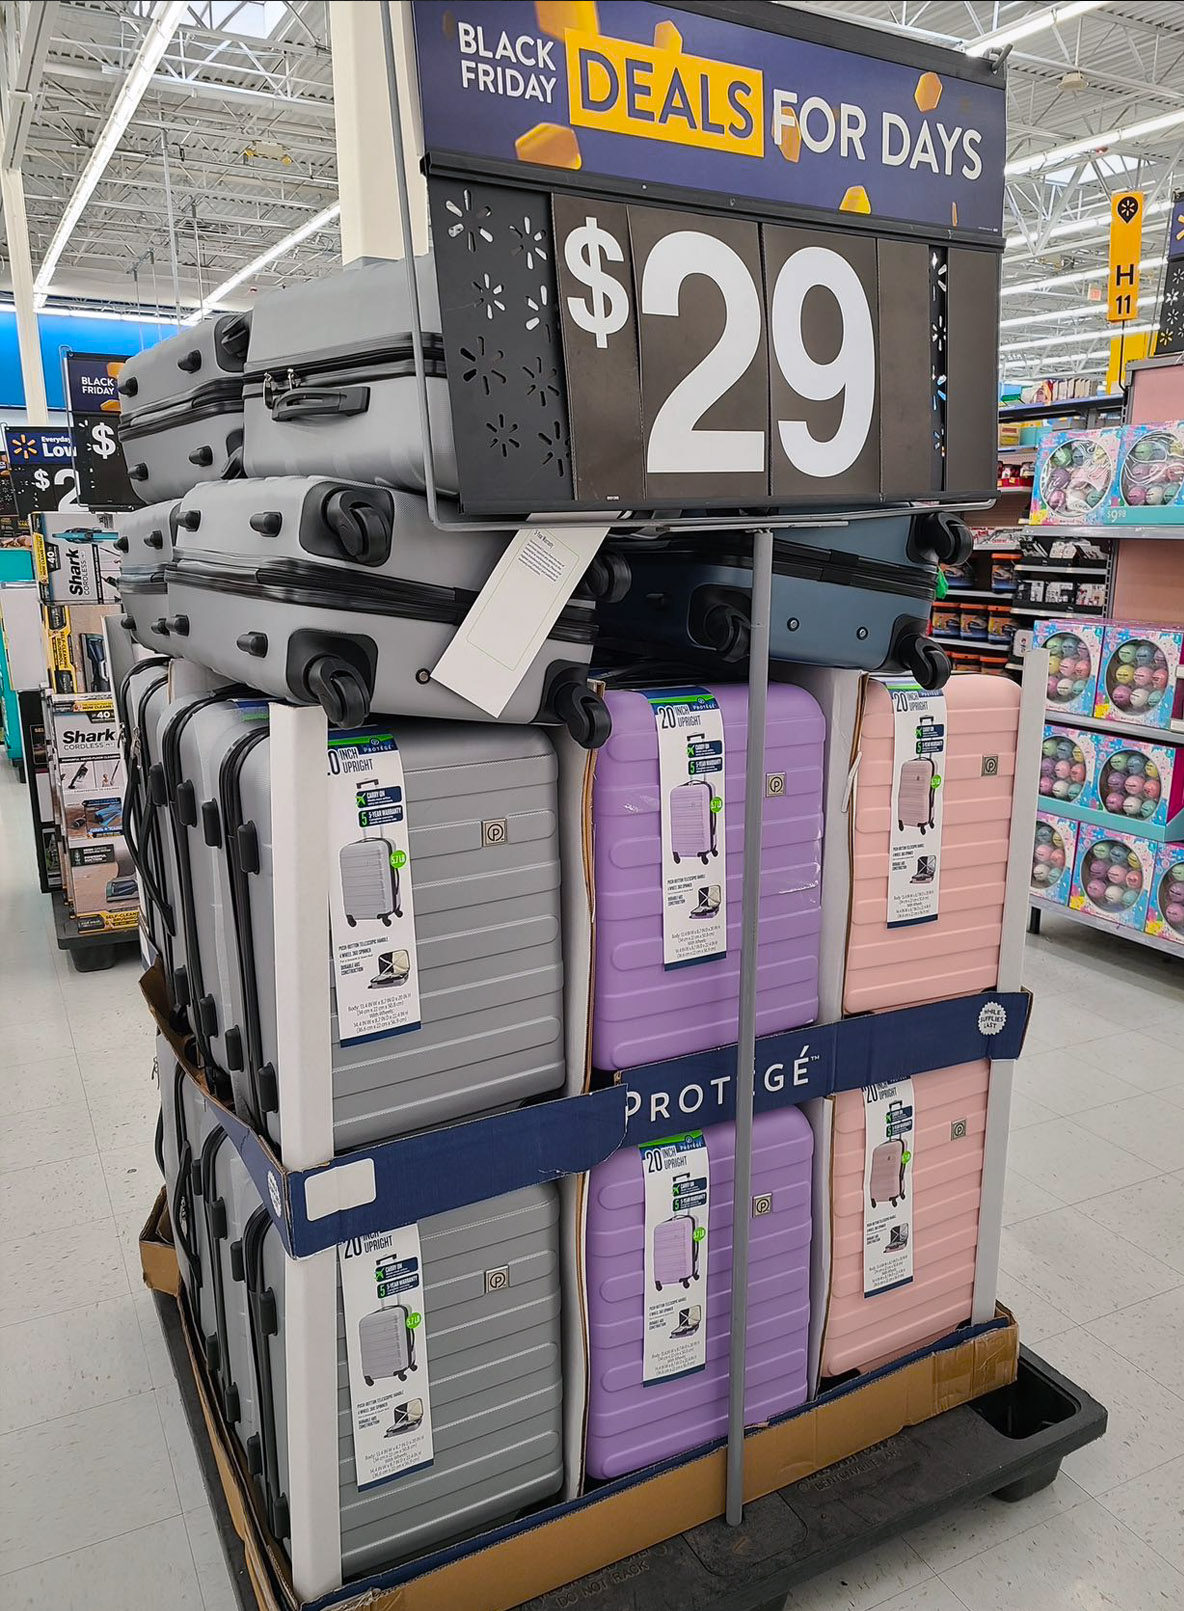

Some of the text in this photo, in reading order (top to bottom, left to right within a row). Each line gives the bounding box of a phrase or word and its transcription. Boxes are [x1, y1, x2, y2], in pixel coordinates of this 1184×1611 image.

[457, 21, 556, 71] BLACK
[461, 60, 557, 104] FRIDAY
[579, 47, 983, 181] DEALS FOR DAYS
[1115, 263, 1134, 287] H
[1115, 295, 1131, 315] 11
[563, 216, 876, 478] $29
[81, 376, 114, 387] BLACK
[82, 385, 115, 396] FRIDAY
[42, 443, 77, 458] Low
[92, 422, 116, 459] $
[66, 548, 83, 596] Shark
[80, 559, 91, 596] CORDLESS
[893, 692, 908, 713] 20
[97, 711, 111, 719] 40
[658, 705, 690, 730] 20 INCH
[677, 715, 701, 727] UPRIGHT
[63, 729, 115, 744] Shark
[63, 743, 104, 751] CORDLESS
[339, 747, 358, 760] INCH
[342, 758, 373, 774] UPRIGHT
[625, 1045, 810, 1122] PROTGÉ
[646, 1146, 676, 1173] 20 INCH
[664, 1155, 688, 1170] UPRIGHT
[364, 1235, 393, 1254] UPRIGHT
[557, 1591, 579, 1608] DO
[581, 1578, 608, 1598] NOT
[611, 1560, 650, 1584] RACK
